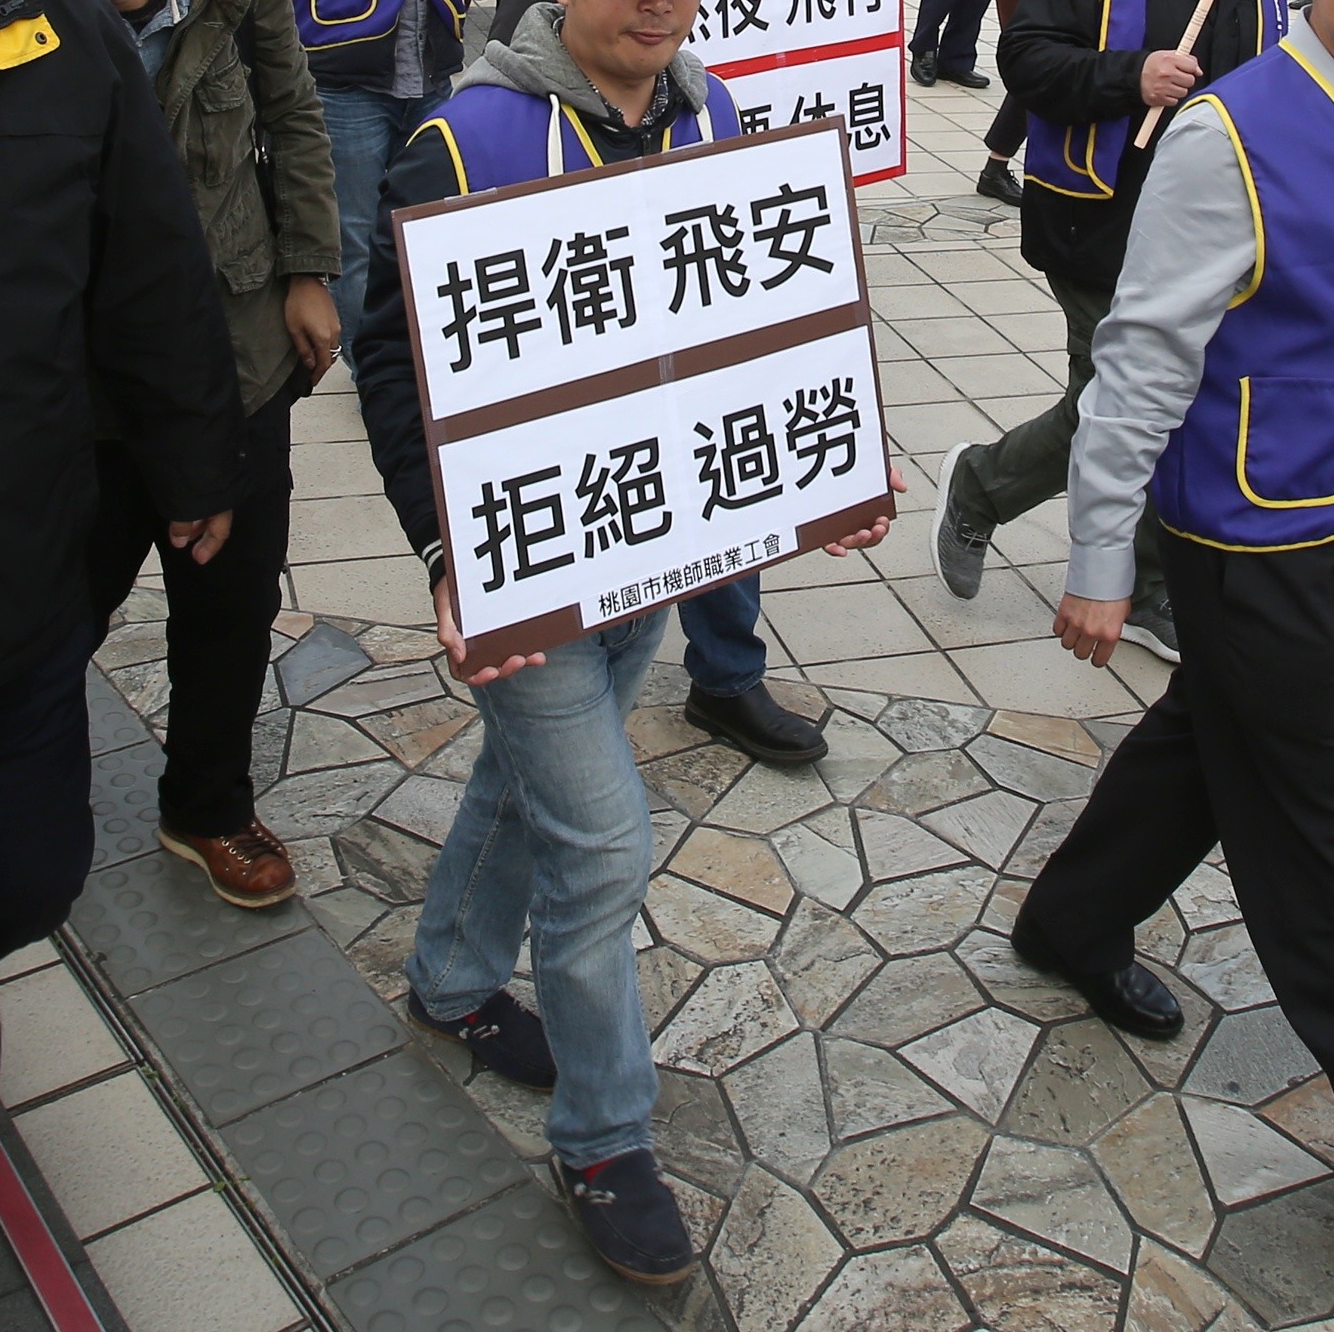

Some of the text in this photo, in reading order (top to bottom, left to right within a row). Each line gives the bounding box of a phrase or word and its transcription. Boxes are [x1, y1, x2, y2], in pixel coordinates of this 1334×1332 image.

[436, 181, 836, 374] 捍衛 飛安
[470, 376, 864, 594] 拒絕 過勞
[598, 532, 784, 620] 桃園市機師職業工會
